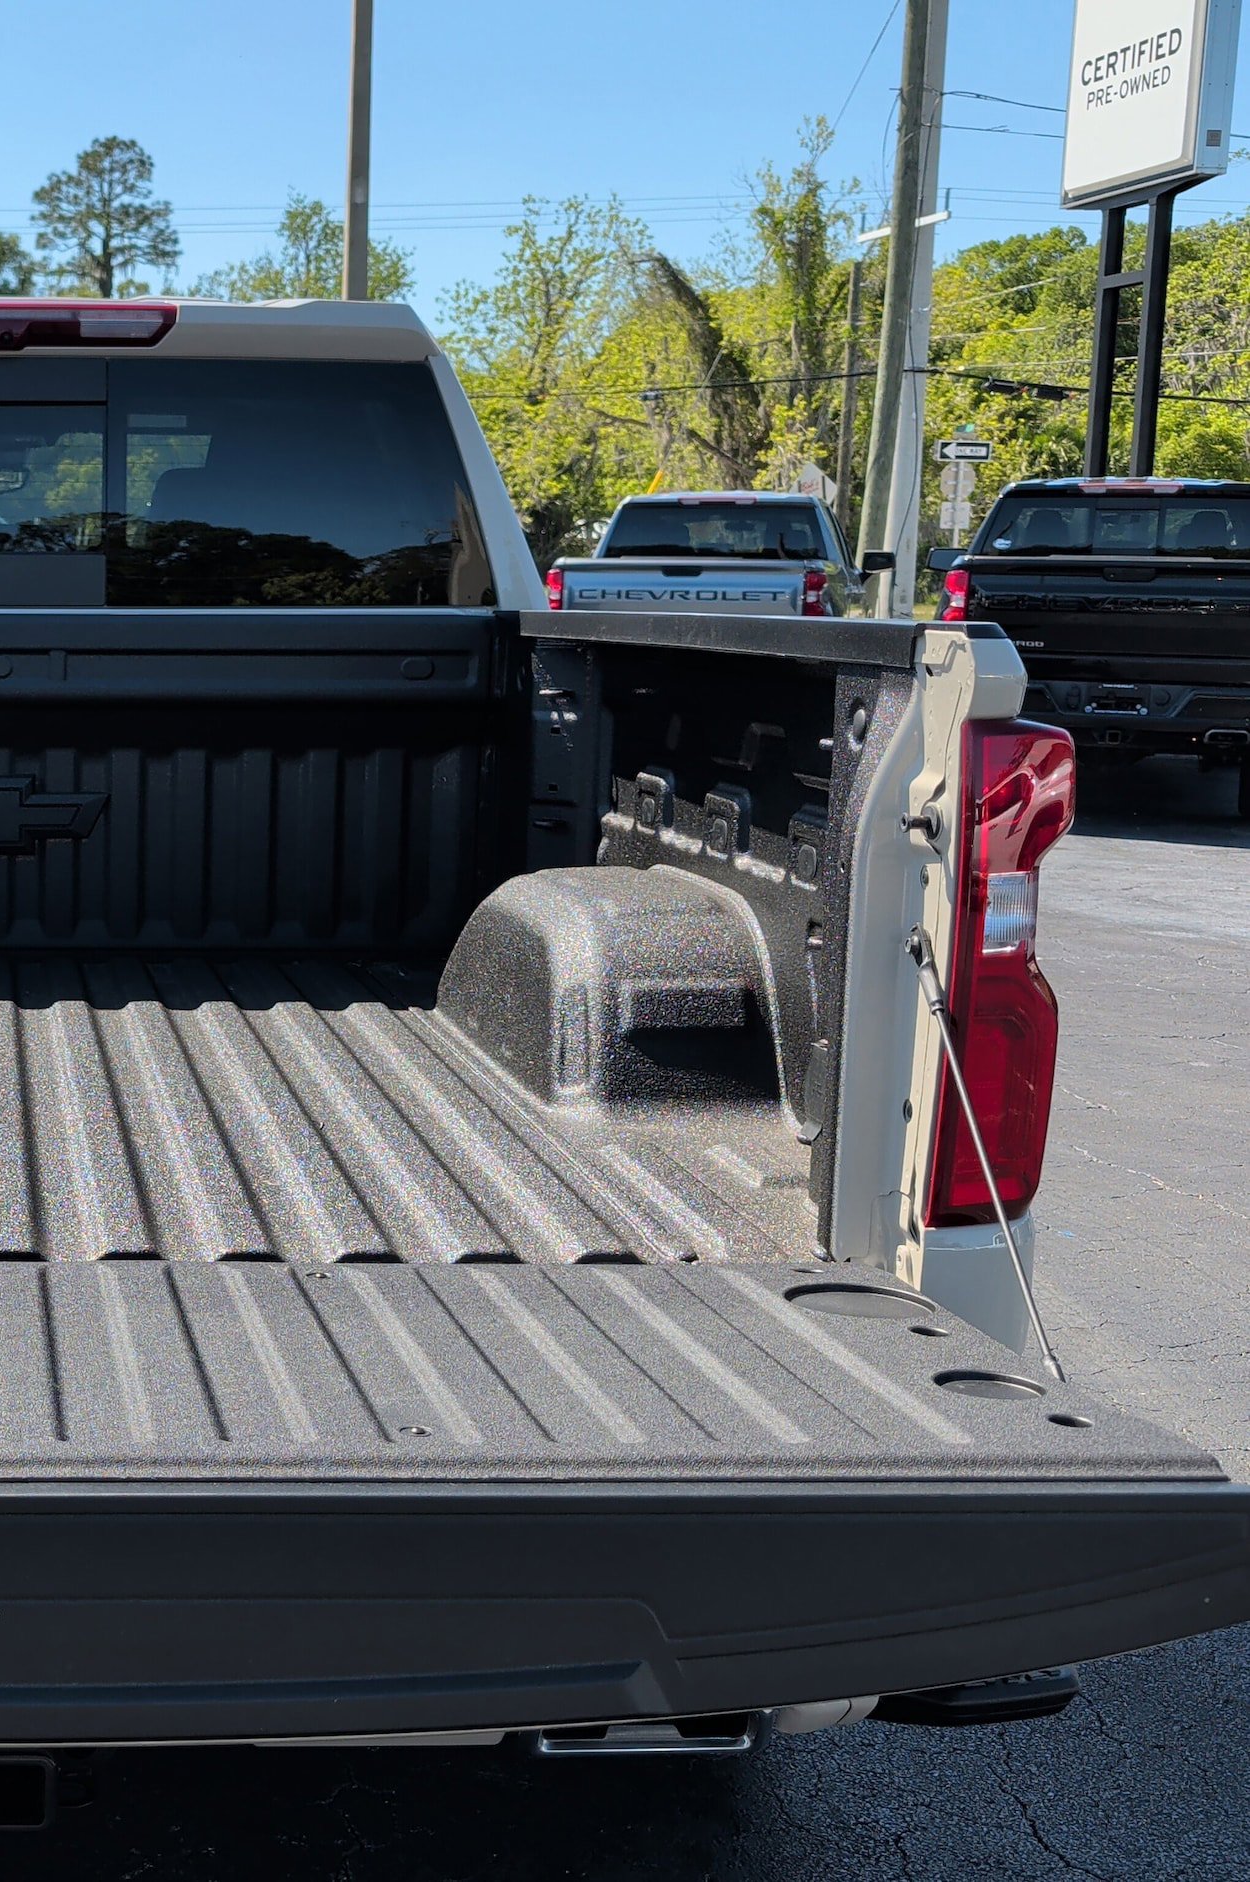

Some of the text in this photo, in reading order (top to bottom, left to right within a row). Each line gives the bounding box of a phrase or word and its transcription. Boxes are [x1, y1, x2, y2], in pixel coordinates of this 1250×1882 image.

[1081, 27, 1183, 87] CERTIFIED
[1086, 65, 1172, 111] PRE-OWNED
[578, 589, 786, 602] CHEVROLET
